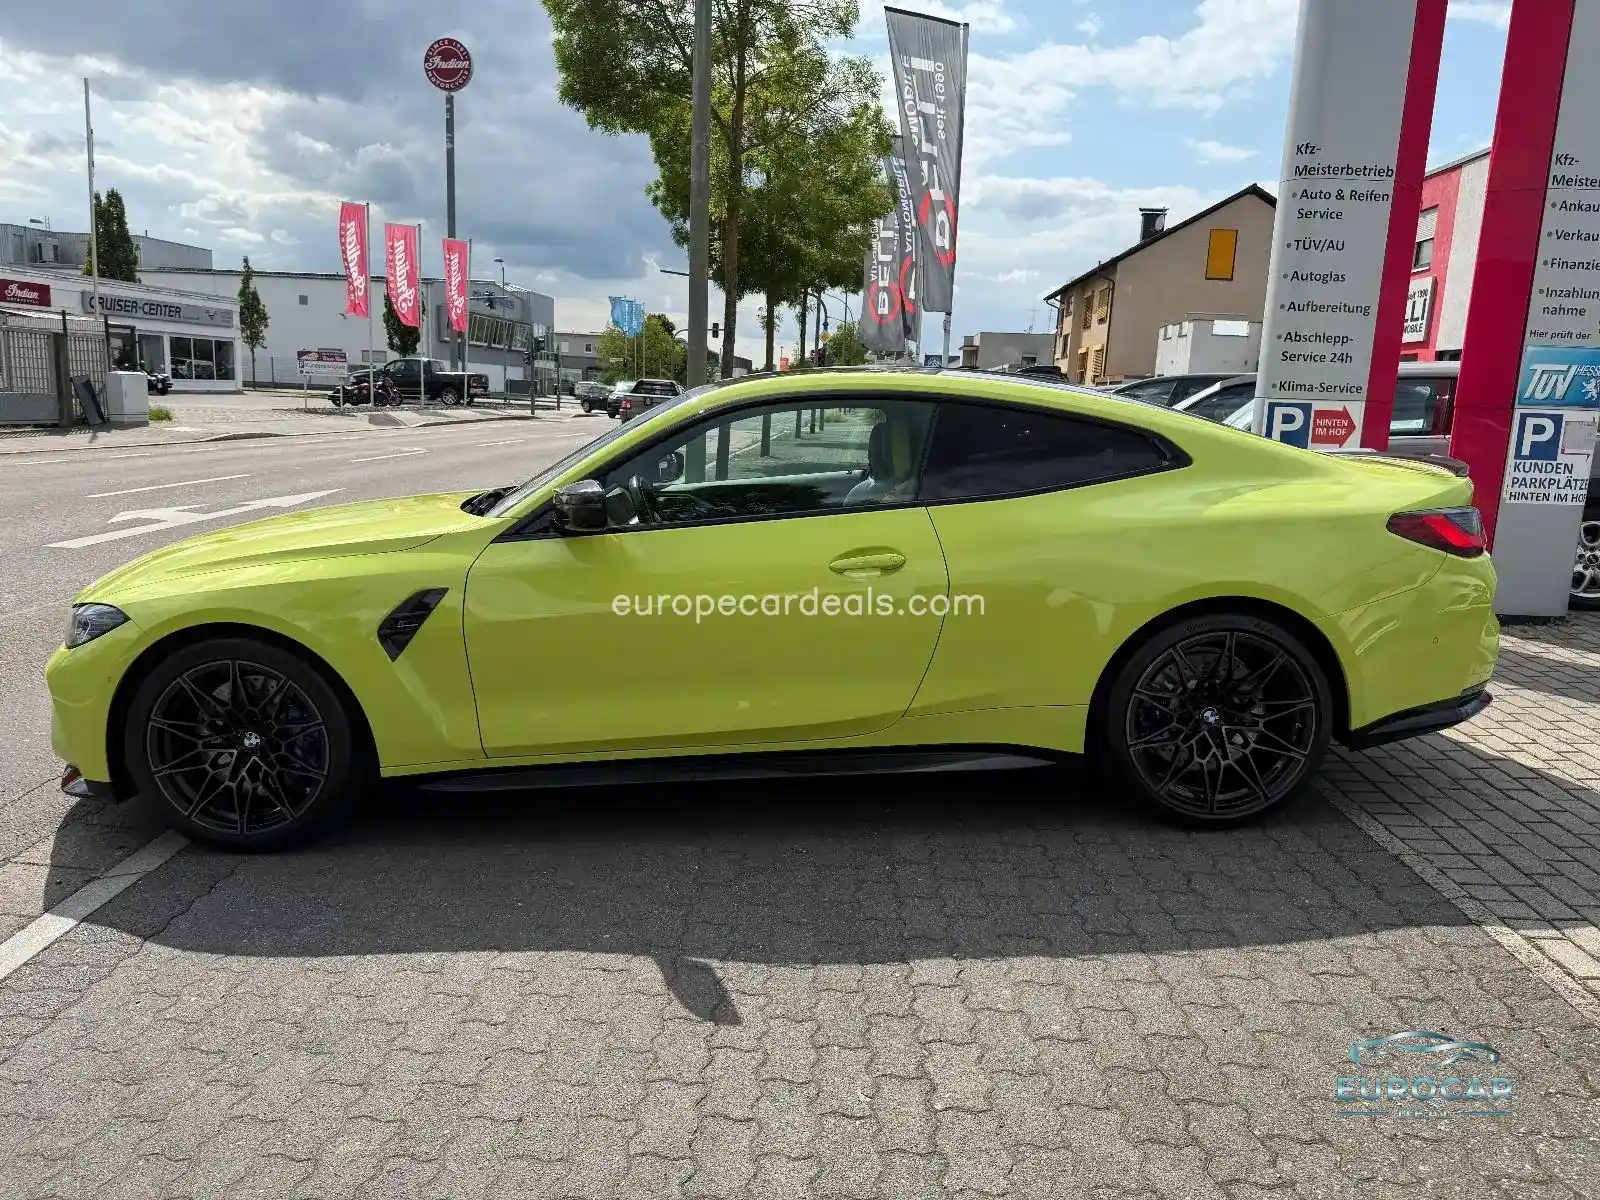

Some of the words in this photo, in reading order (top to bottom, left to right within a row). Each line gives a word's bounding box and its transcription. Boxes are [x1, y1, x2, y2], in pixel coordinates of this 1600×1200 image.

[425, 55, 469, 69] Indian
[1296, 142, 1322, 155] Kfz-
[1555, 153, 1580, 166] Kfz-
[1294, 163, 1394, 177] Meisterbetrieb
[1299, 188, 1332, 200] Auto
[1335, 188, 1345, 200] &
[1350, 189, 1390, 202] Reifen
[1296, 208, 1343, 220] Service
[1294, 237, 1345, 252] TÜV/AU
[1290, 270, 1346, 285] Autoglas
[5, 283, 39, 299] Indian
[1545, 286, 1600, 302] Inzahlun
[89, 295, 182, 318] CRUISER-CENTER
[1287, 301, 1371, 316] Aufbereitung
[1542, 305, 1586, 317] nahme
[1283, 331, 1354, 346] Abschlepp-
[1529, 329, 1549, 339] Hier
[1550, 330, 1574, 341] prüft
[1575, 331, 1592, 340] der
[1280, 350, 1326, 363] Service
[1330, 352, 1353, 364] 24h
[1278, 381, 1363, 394] Klima-Service
[1272, 406, 1304, 442] P
[1316, 418, 1349, 427] HINTEN
[1315, 427, 1327, 436] IM
[1328, 428, 1347, 436] HOF
[1521, 417, 1554, 456] P
[1513, 461, 1574, 475] KUNDEN
[1509, 491, 1550, 502] HINTEN
[1554, 492, 1568, 502] IM
